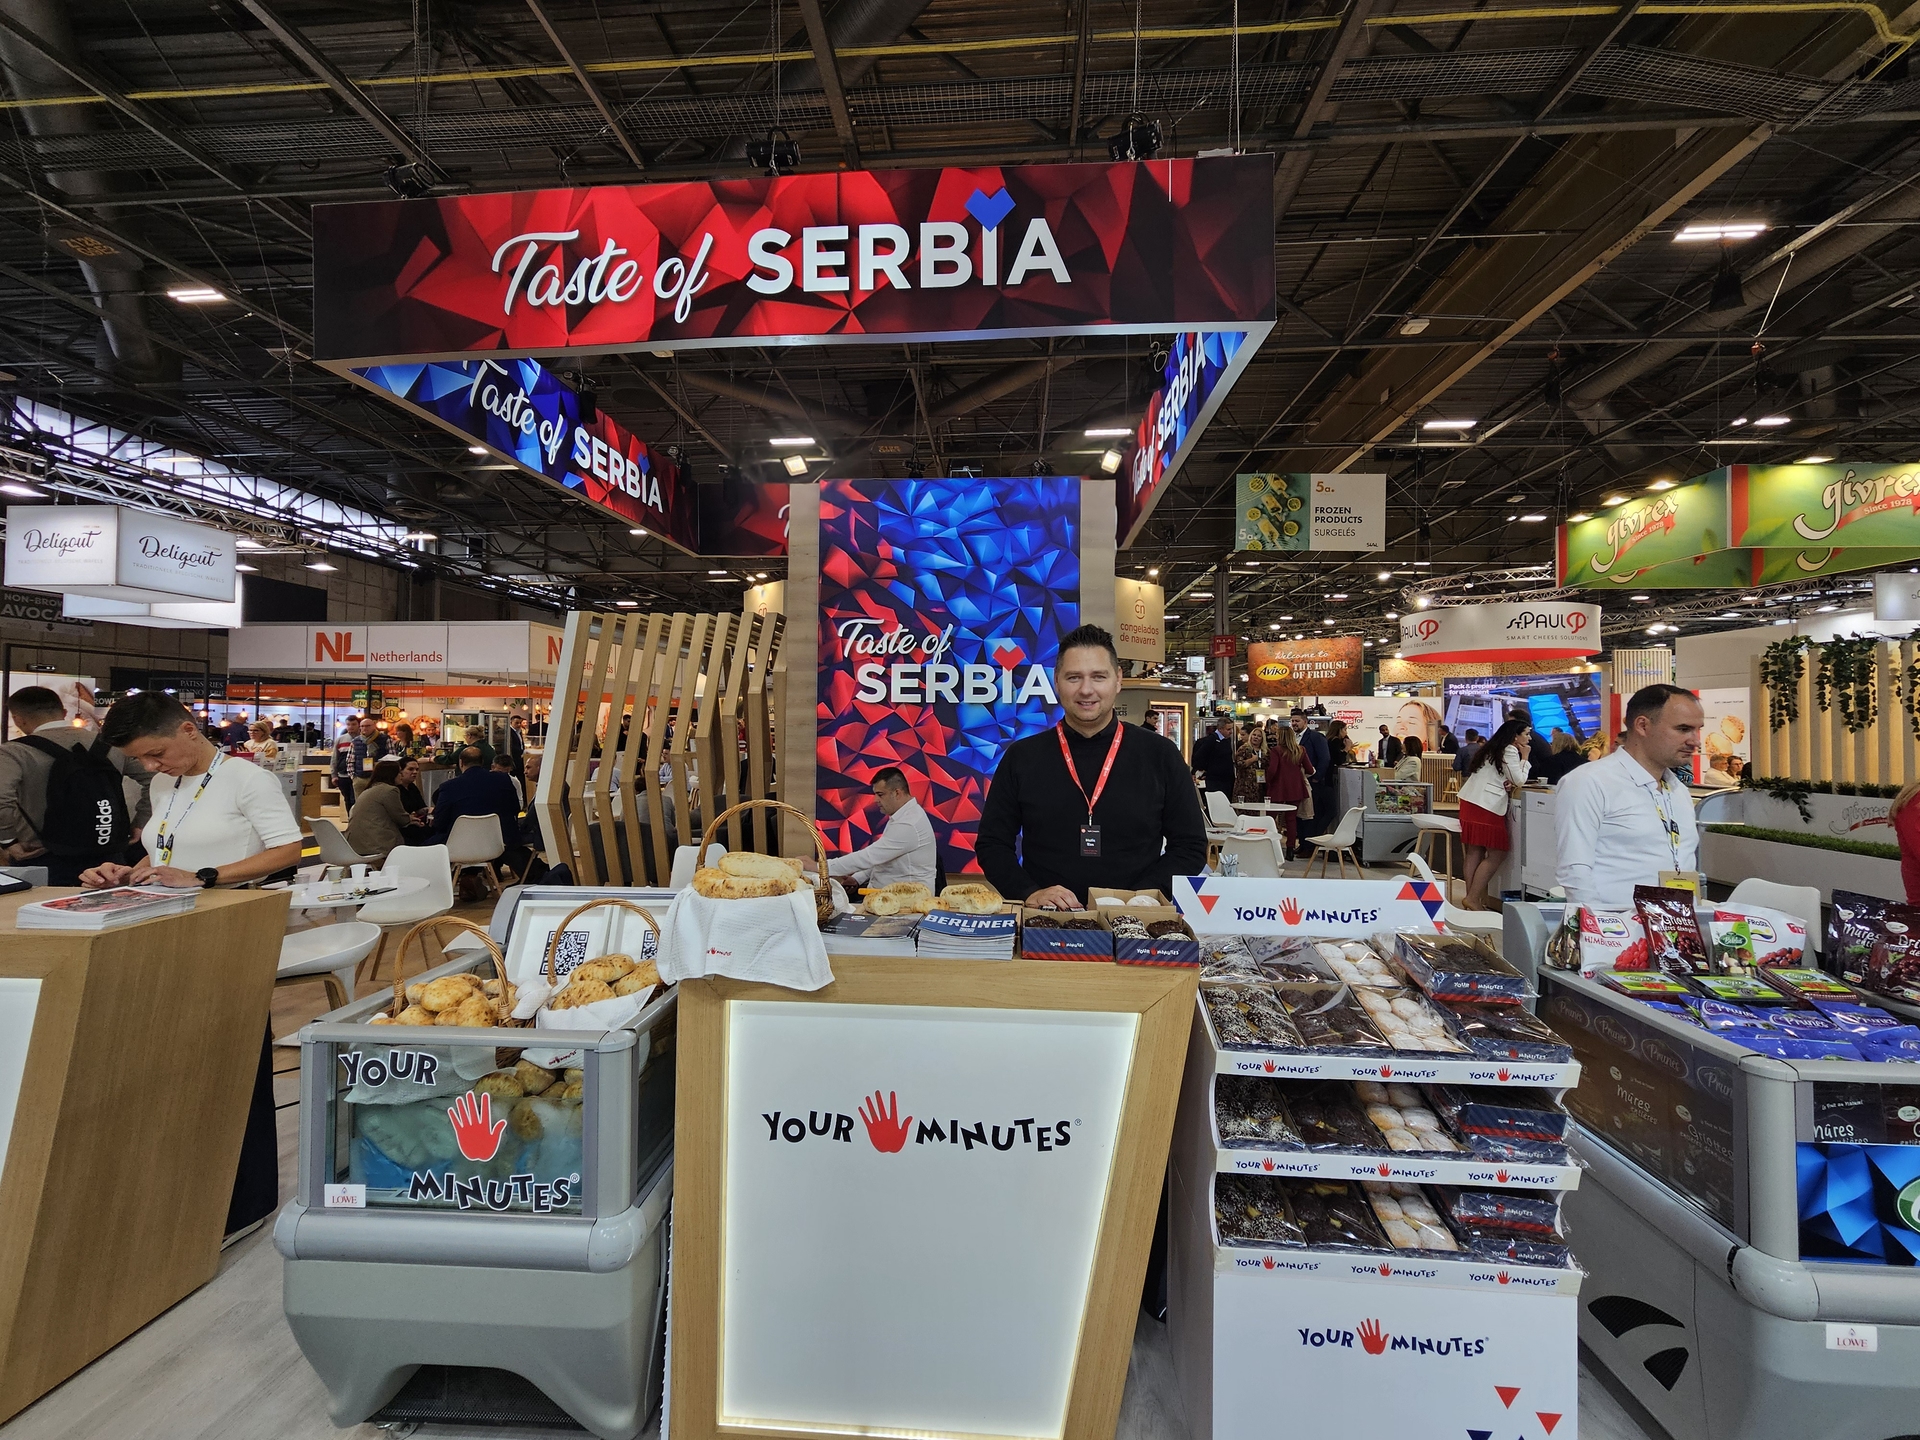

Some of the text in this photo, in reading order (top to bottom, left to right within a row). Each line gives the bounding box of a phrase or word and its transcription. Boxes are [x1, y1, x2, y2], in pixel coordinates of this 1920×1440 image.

[492, 212, 1073, 323] Taste of SERBIA
[1157, 332, 1207, 451] SERBIA
[462, 359, 663, 514] Taste of SERBIA
[1314, 506, 1352, 515] FROZEN
[1863, 498, 1912, 515] Since 1978
[1314, 516, 1363, 524] PRODUCTS
[1314, 527, 1356, 537] SURGELÉS
[1632, 521, 1664, 544] Since 1978
[23, 528, 102, 556] Deligout
[138, 535, 223, 570] Deligout
[1120, 622, 1159, 636] congelados
[837, 618, 951, 665] Taste of
[1119, 632, 1156, 646] de navarra
[315, 631, 443, 663] NL Netherlands
[1275, 650, 1329, 660] Welcome to
[1293, 661, 1349, 671] THE HOUSE
[1292, 669, 1337, 679] OF FRIES
[180, 680, 224, 688] PATISSRIES
[855, 662, 1058, 705] SERBIA
[95, 799, 113, 846] adidas
[924, 914, 1015, 928] BERLINER
[1234, 906, 1378, 924] YOUR MINUTES
[1784, 1016, 1829, 1028] Prunes
[1601, 1019, 1627, 1045] Prunes
[1649, 1044, 1680, 1072] Prunes
[338, 1050, 439, 1087] YOUR
[1236, 1062, 1320, 1074] YOUR MINUTES
[1351, 1068, 1436, 1078] YOUR MINUTES
[1469, 1072, 1555, 1081] YOUR MINUTES
[1706, 1071, 1733, 1099] Prun
[761, 1110, 855, 1144] YOUR
[1235, 1161, 1319, 1172] YOUR MINUTES
[1350, 1166, 1435, 1178] YOUR MINUTES
[1468, 1172, 1555, 1184] YOUR MINUTES
[331, 1195, 358, 1204] LOWE
[1236, 1258, 1319, 1271] YOUR MINUTES
[1351, 1265, 1436, 1278] YOUR MINUTES
[1469, 1273, 1556, 1286] YOUR MINUTES
[1297, 1328, 1485, 1357] YOUR MINUTES
[1837, 1337, 1868, 1348] LOWE
